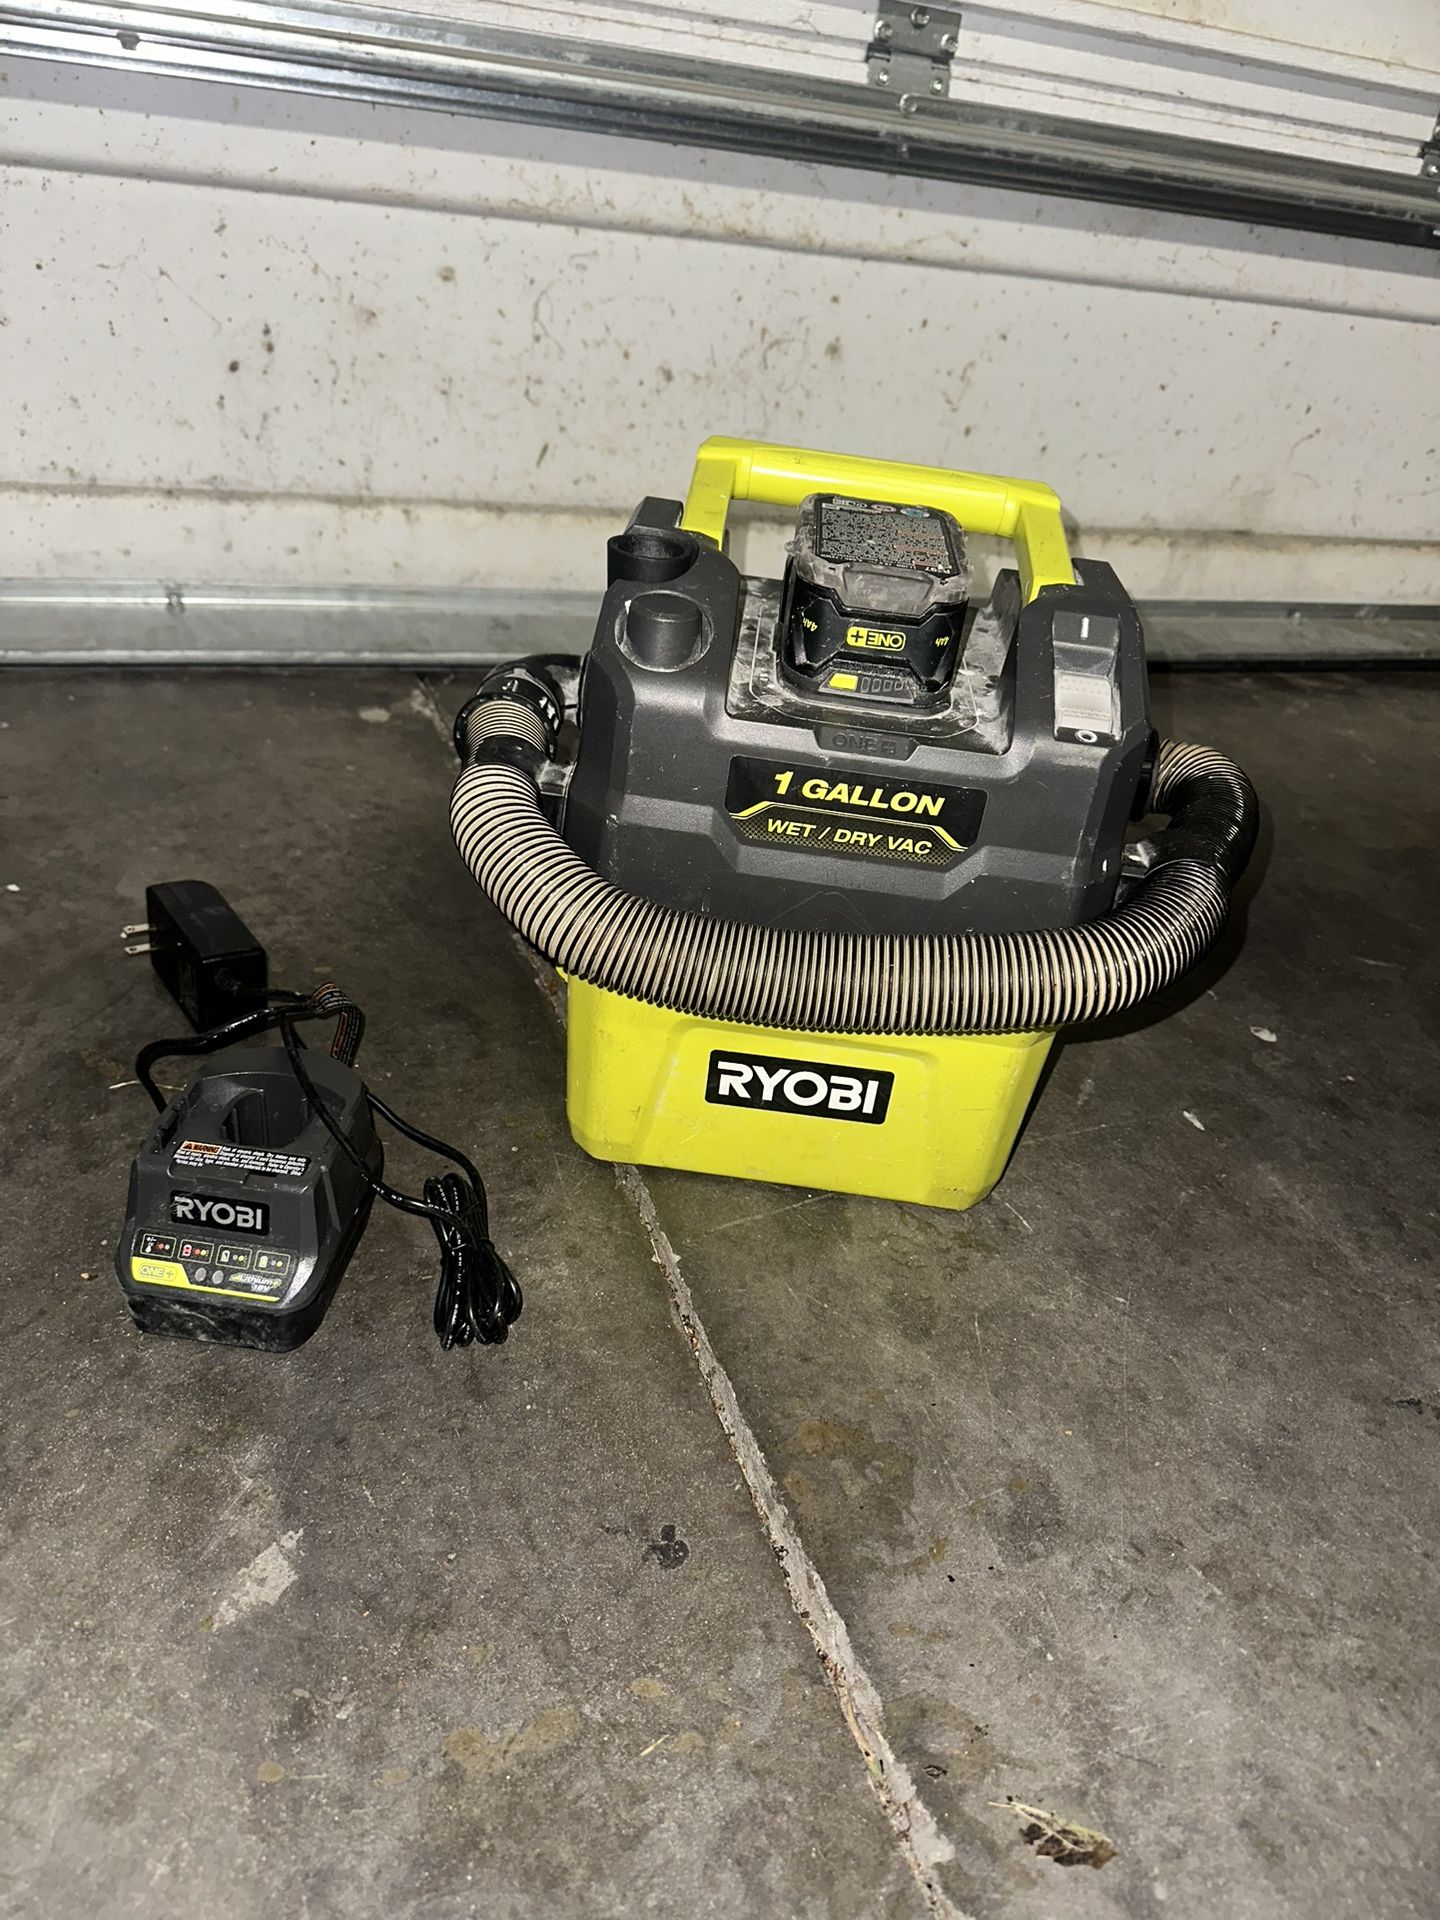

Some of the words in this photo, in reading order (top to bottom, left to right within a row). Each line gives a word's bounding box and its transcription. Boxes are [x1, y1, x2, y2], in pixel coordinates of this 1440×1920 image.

[849, 629, 903, 648] ONE+
[774, 771, 794, 795] 1
[801, 779, 946, 816] GALLON
[767, 818, 817, 838] WET
[833, 829, 883, 847] DRY
[887, 836, 933, 854] VAC
[717, 1060, 880, 1115] RYOBI
[174, 1196, 263, 1230] RYOBI
